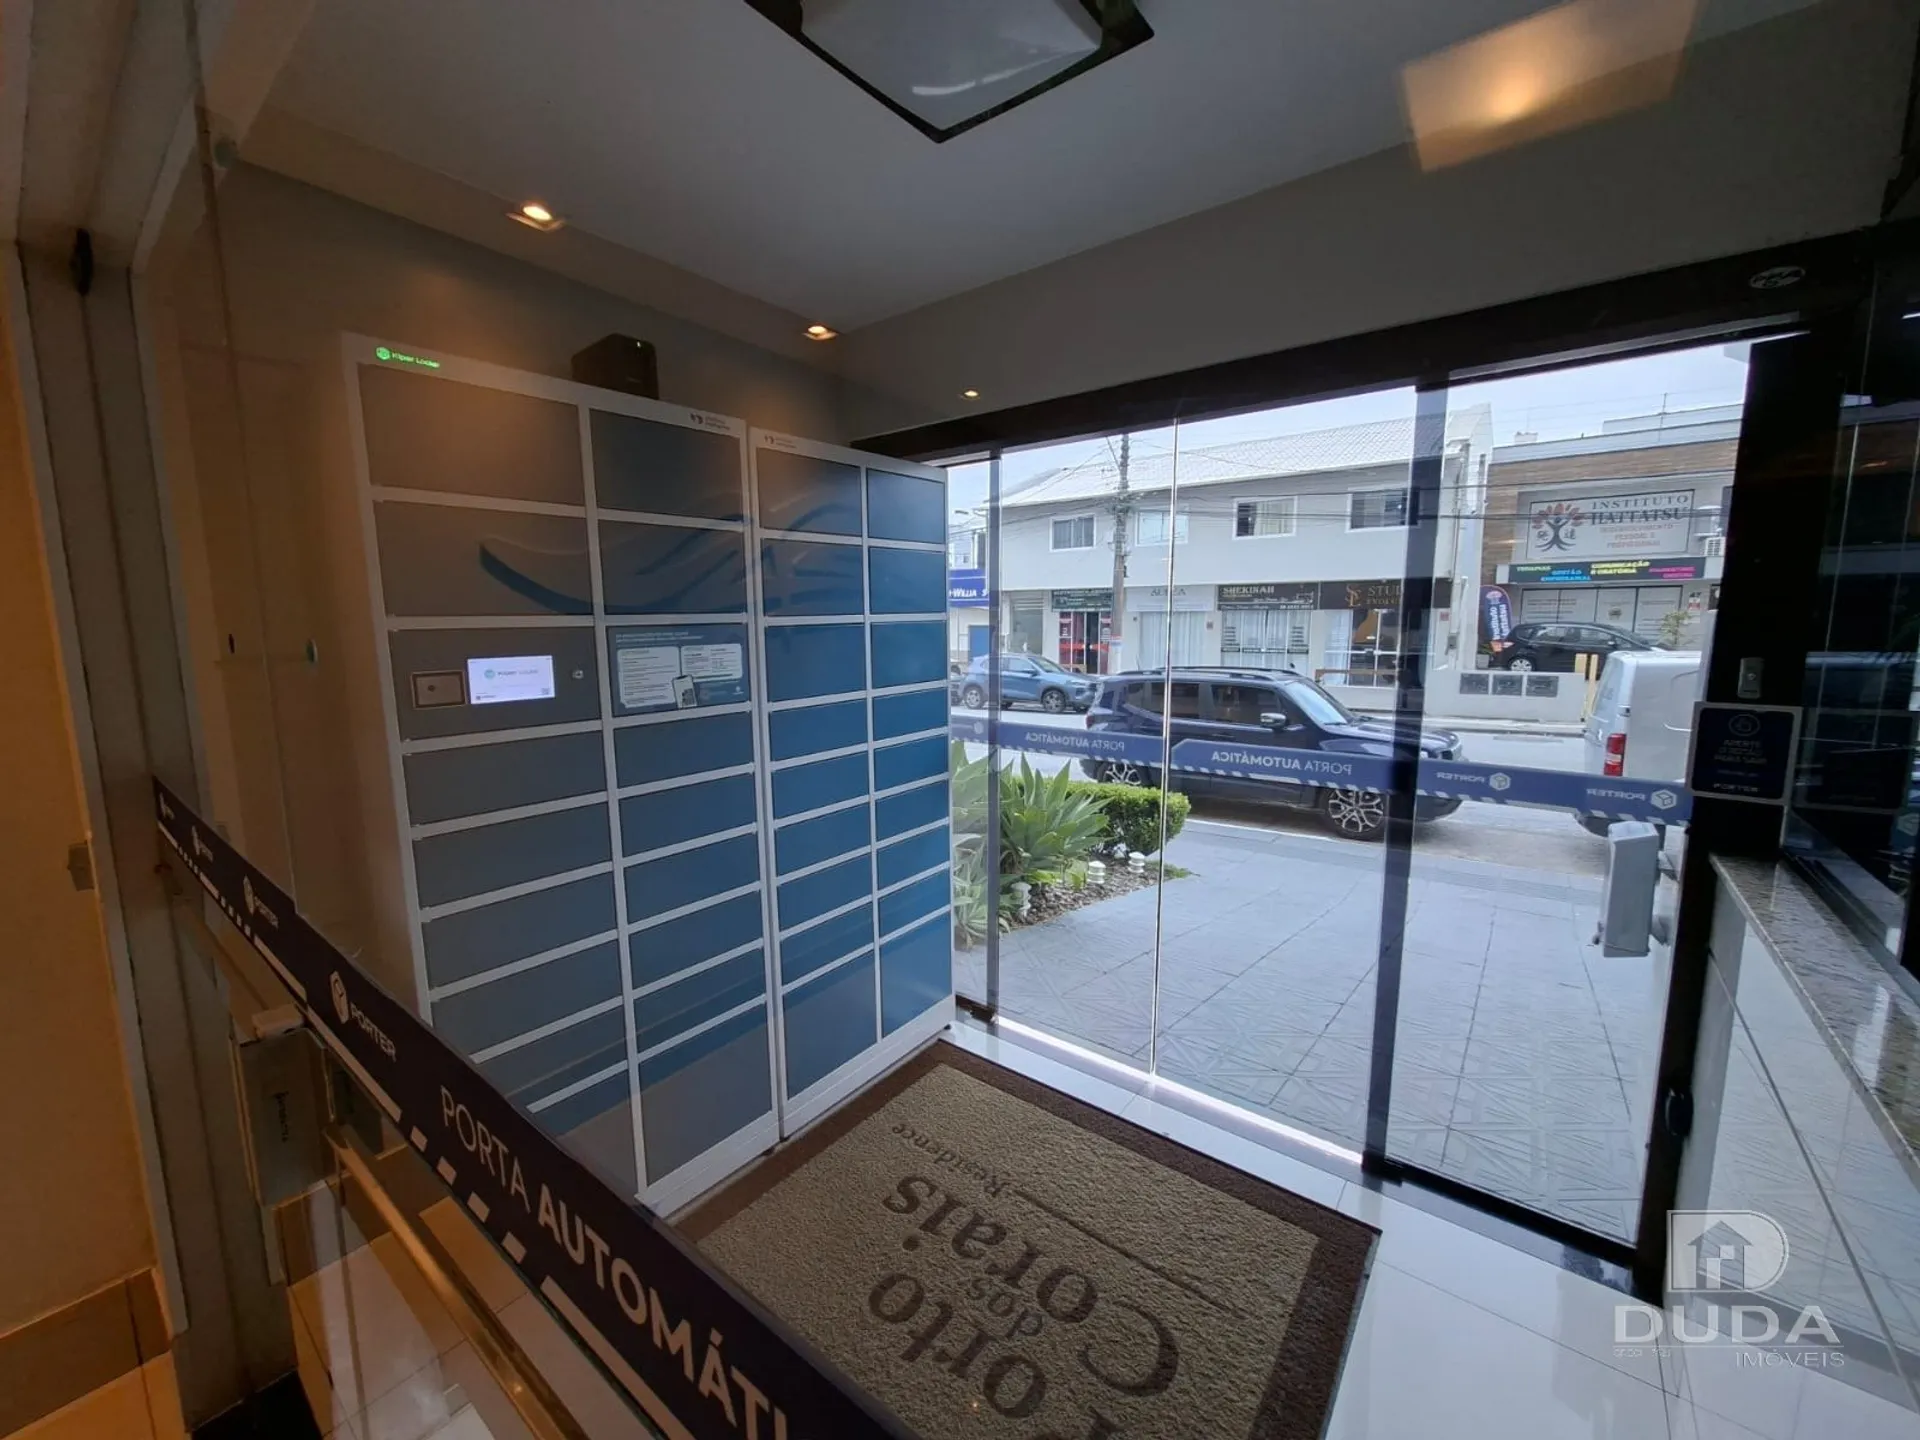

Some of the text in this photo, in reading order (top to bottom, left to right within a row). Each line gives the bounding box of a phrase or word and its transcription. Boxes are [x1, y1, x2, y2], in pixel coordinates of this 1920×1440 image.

[1592, 495, 1688, 510] INSTITUTO
[1368, 585, 1401, 597] STU
[350, 1001, 397, 1063] PORTER
[440, 1085, 531, 1213] PORTA
[892, 1122, 1010, 1197] Residence
[882, 1175, 1180, 1398] Corais
[967, 1275, 1044, 1340] dos
